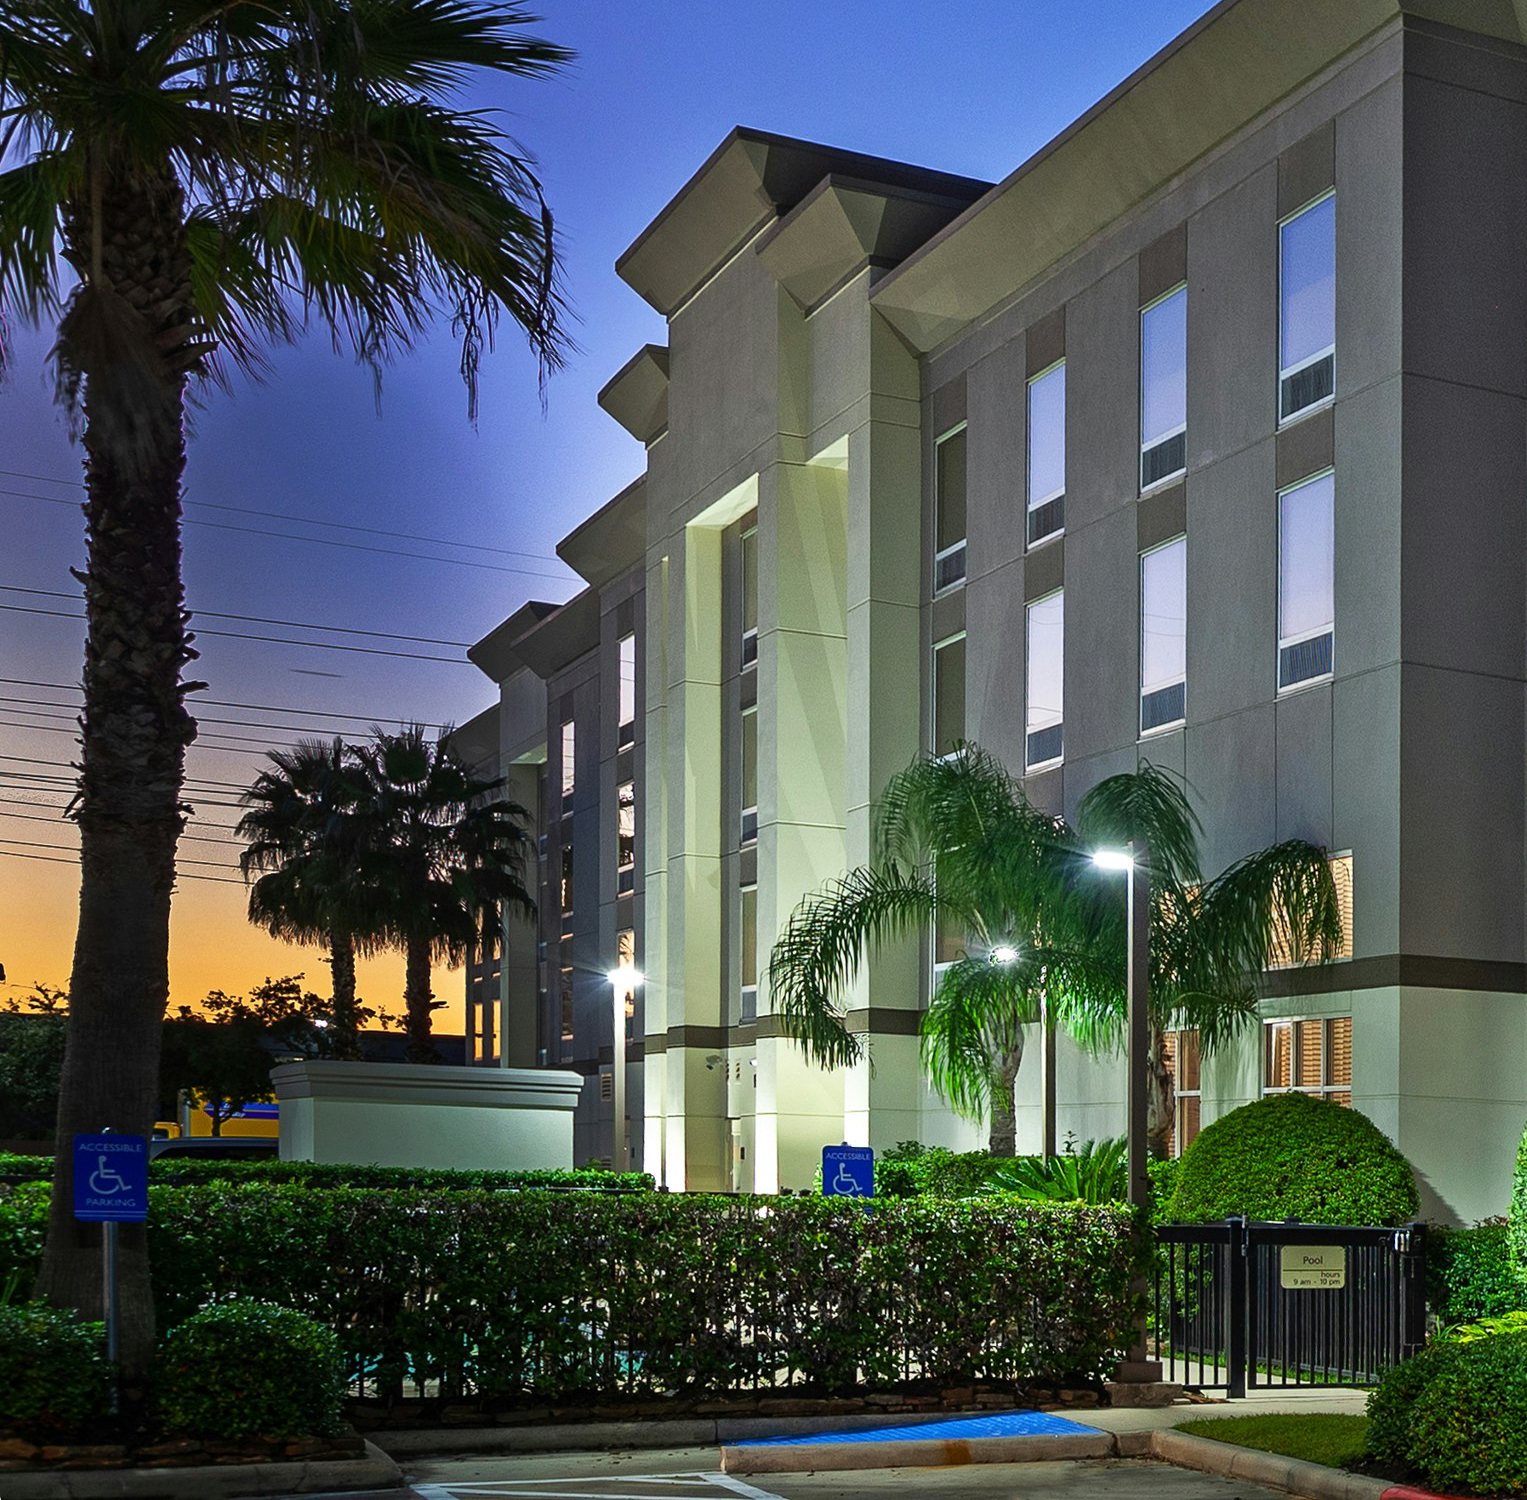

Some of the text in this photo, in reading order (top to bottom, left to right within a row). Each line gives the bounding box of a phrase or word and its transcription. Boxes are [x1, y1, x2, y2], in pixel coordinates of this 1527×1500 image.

[79, 1143, 142, 1152] ACCESSIBLE
[825, 1152, 870, 1160] ACCESSIBLE
[86, 1198, 136, 1206] PARKING
[1303, 1256, 1323, 1264] Pool
